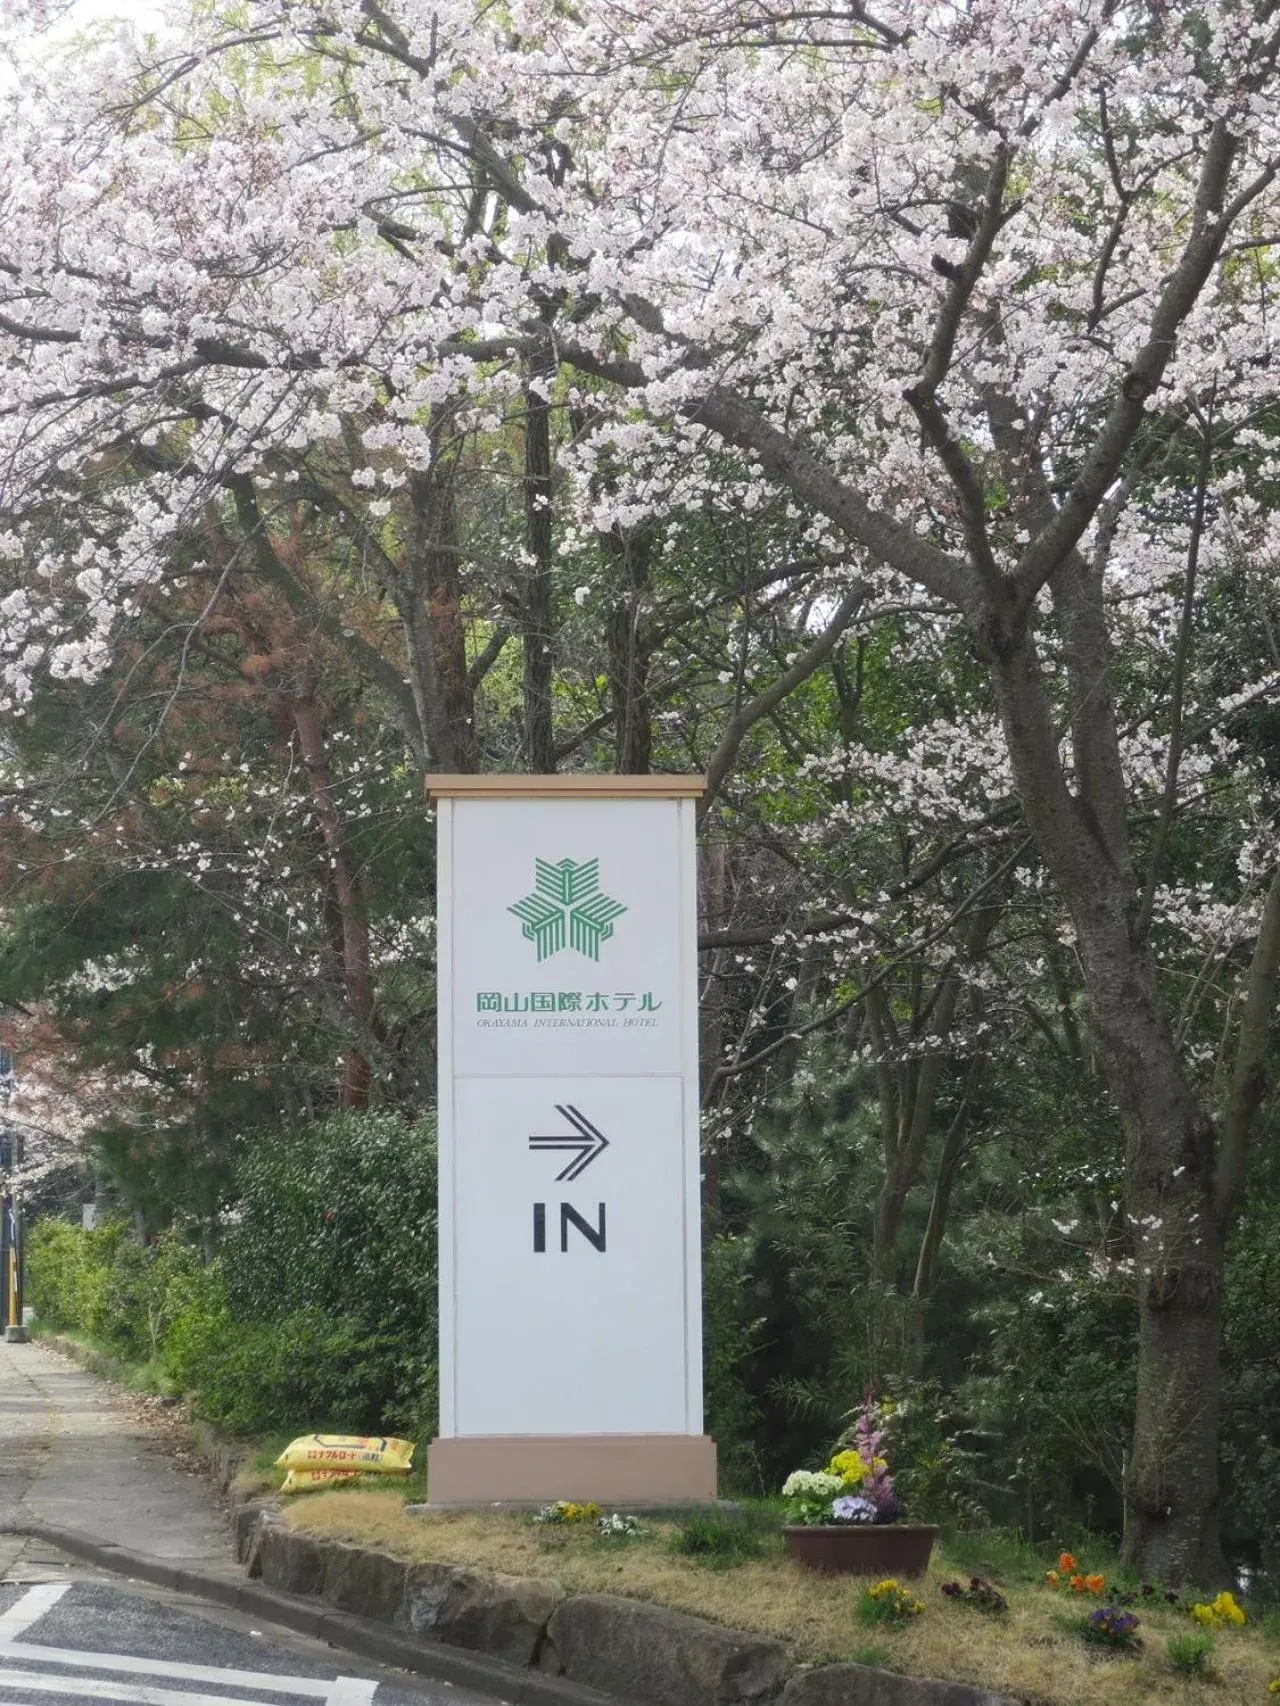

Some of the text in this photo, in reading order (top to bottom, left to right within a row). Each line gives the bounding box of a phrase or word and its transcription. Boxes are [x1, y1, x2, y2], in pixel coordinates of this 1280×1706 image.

[476, 991, 663, 1012] 岡山国際ホテル
[477, 1018, 659, 1028] OKAYAMA INTERNATIONAL HOTEL
[533, 1202, 606, 1252] IN
